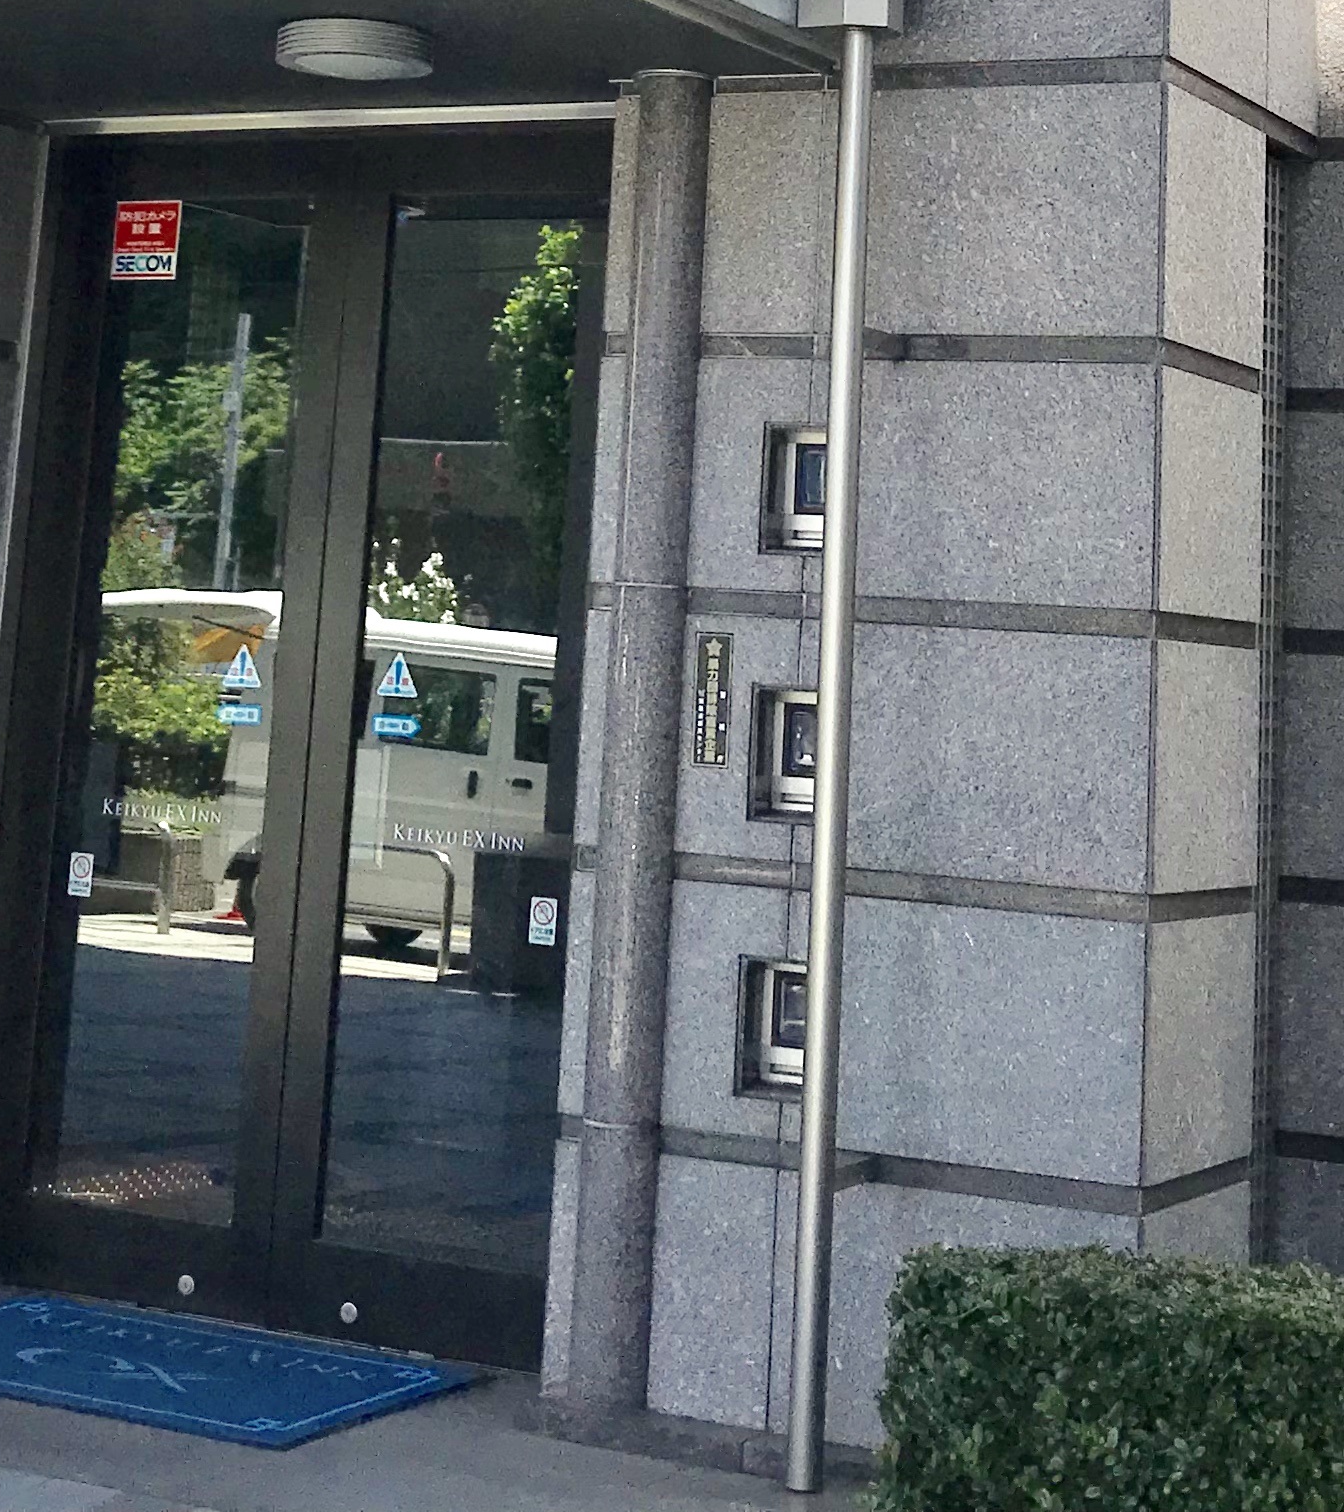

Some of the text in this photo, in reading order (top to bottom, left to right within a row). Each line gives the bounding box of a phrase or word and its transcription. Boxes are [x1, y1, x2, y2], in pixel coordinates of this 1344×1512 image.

[116, 255, 172, 272] SECOM
[102, 797, 222, 823] KEIKYU EX INN
[393, 823, 524, 852] KEIKYU EX INN
